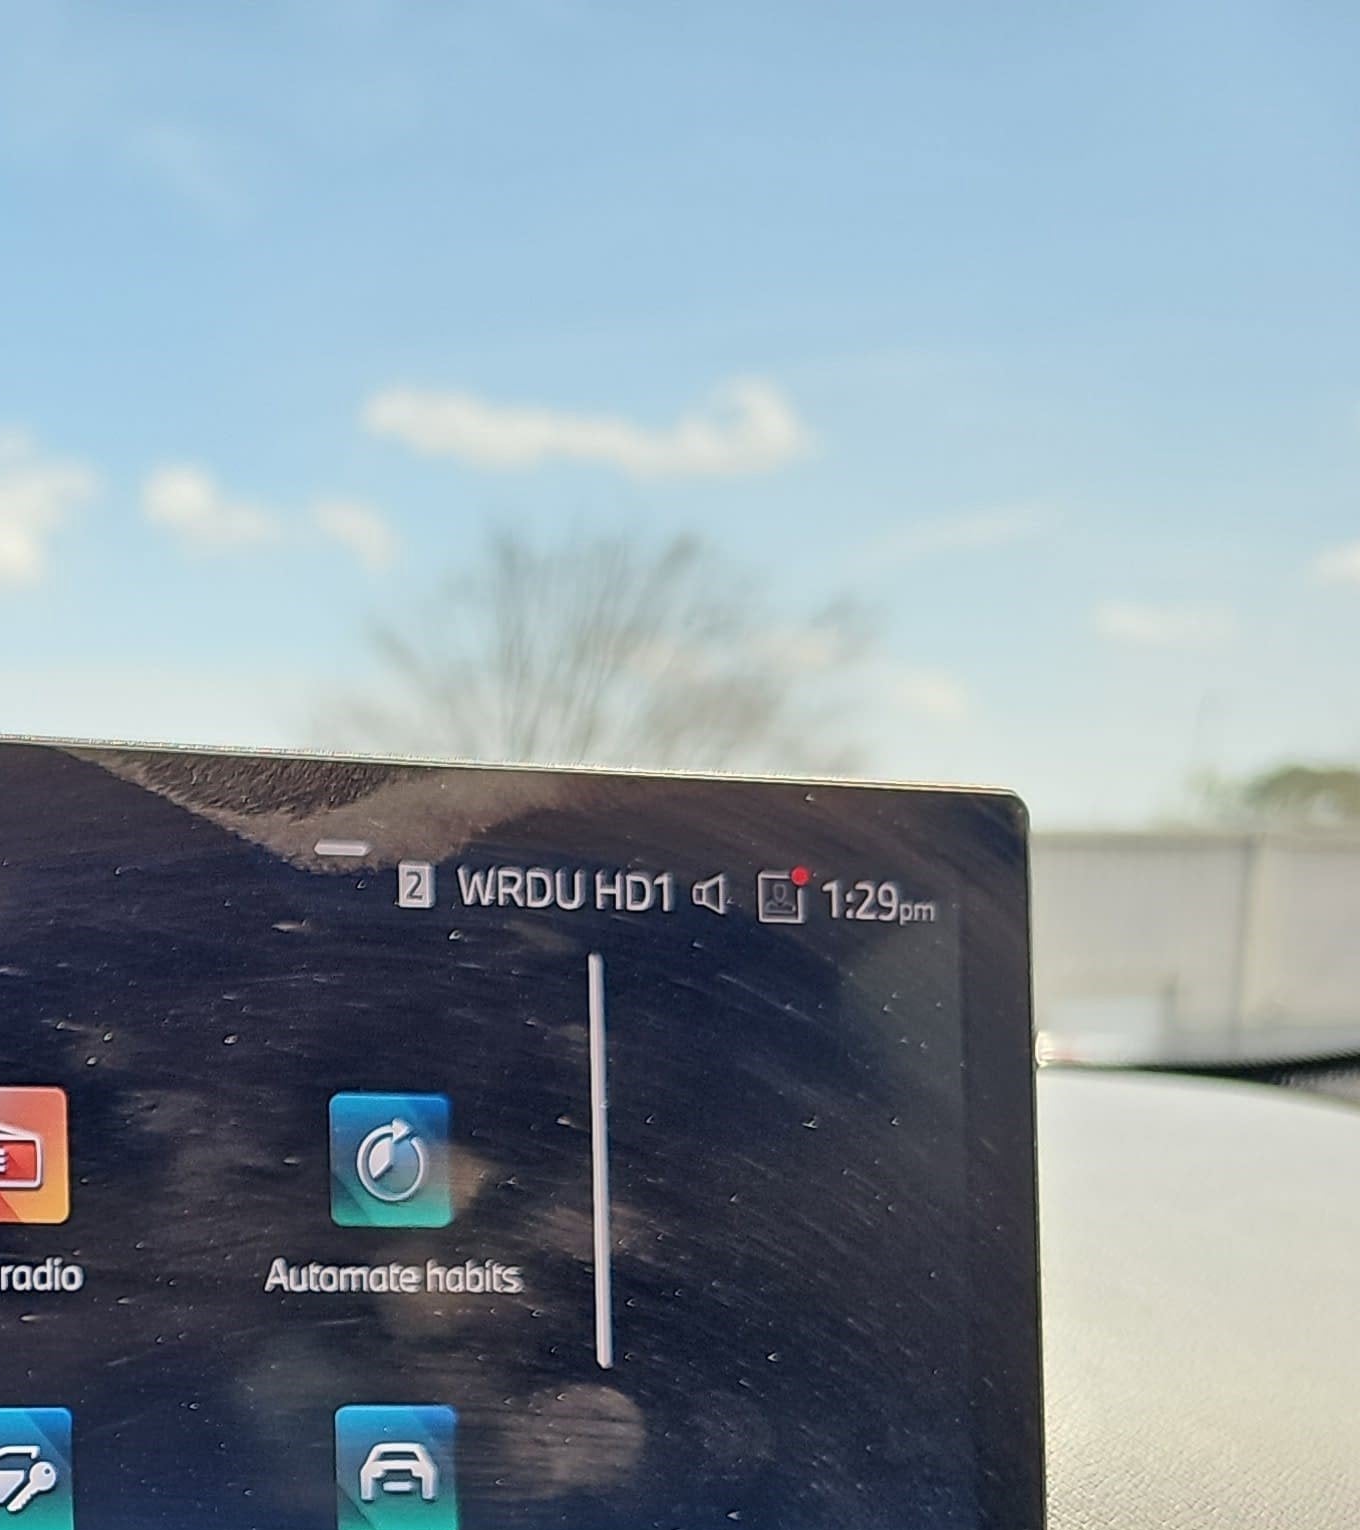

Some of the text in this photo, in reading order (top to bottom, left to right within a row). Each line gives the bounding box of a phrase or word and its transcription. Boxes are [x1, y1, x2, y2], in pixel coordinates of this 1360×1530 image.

[456, 865, 584, 911] WRDU
[594, 870, 673, 913] HD1
[0, 1256, 84, 1292] radio
[264, 1258, 524, 1294] Automate habits
